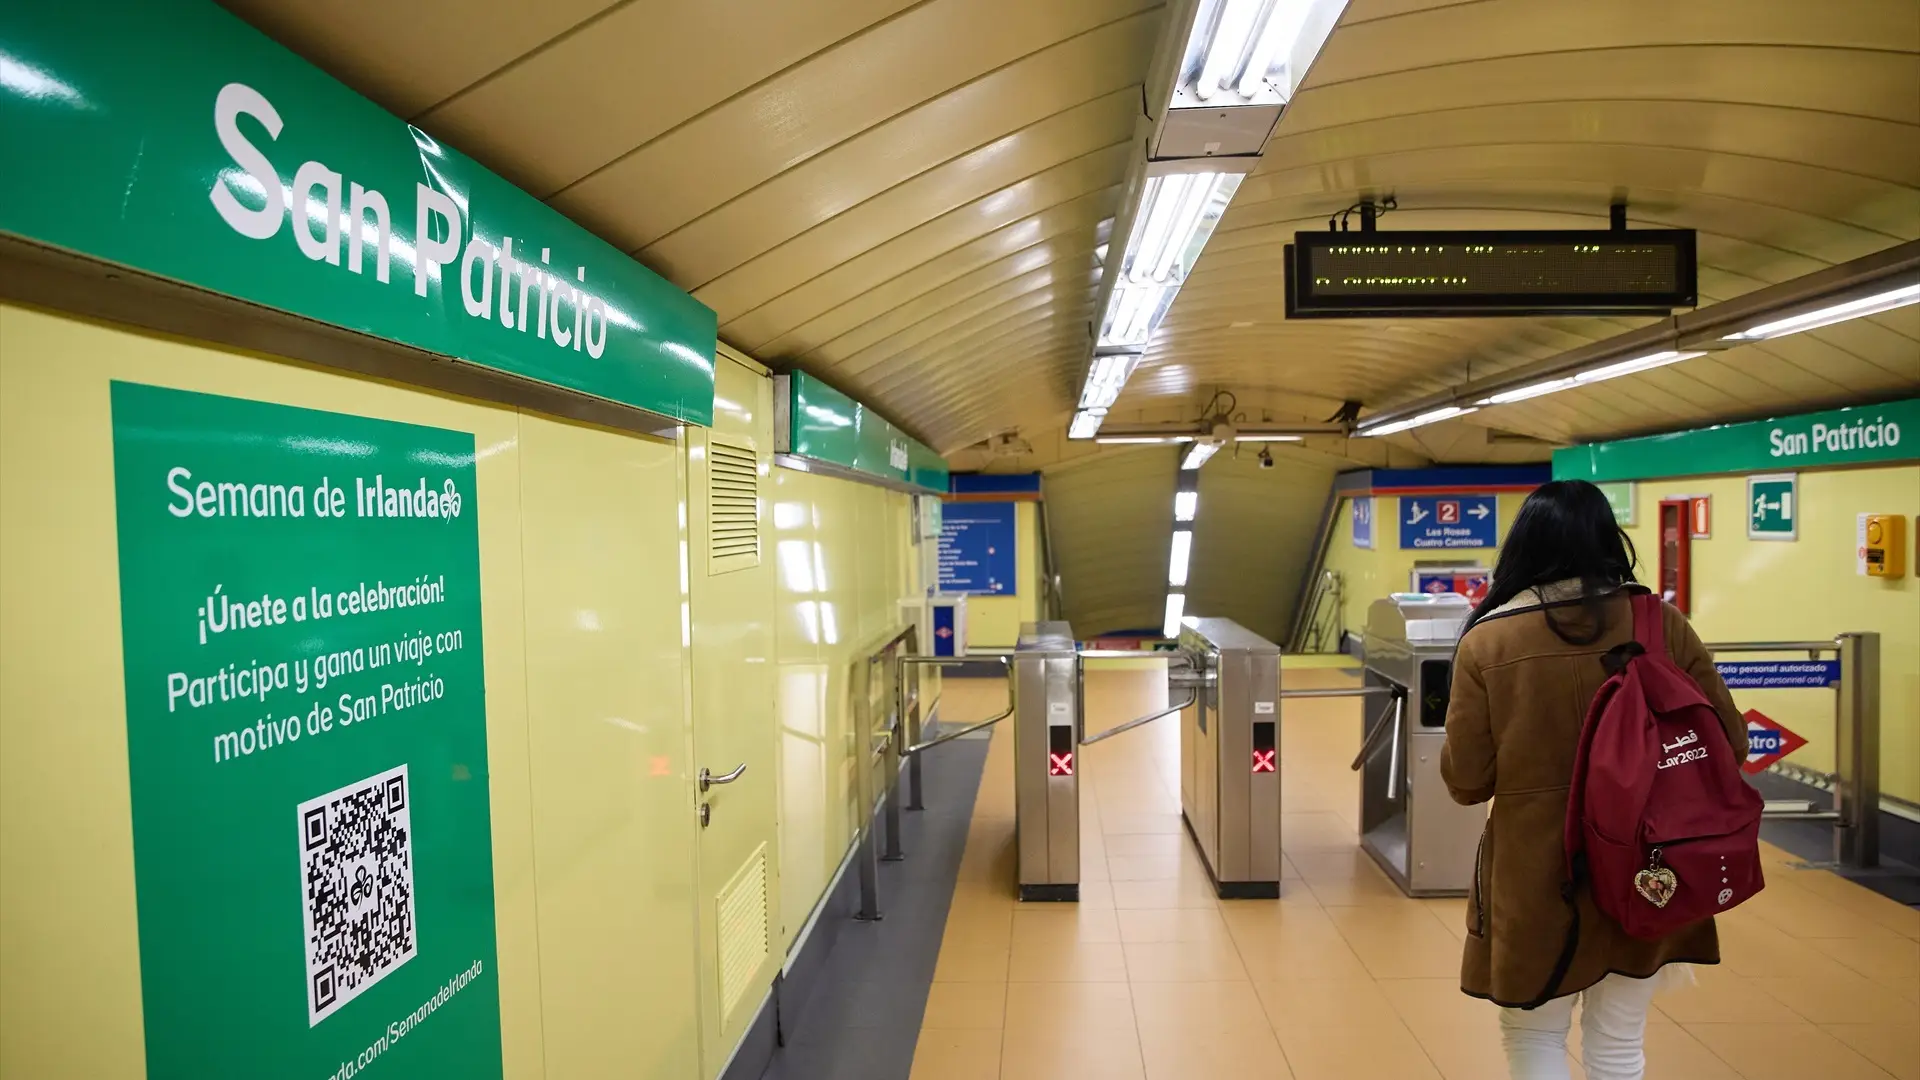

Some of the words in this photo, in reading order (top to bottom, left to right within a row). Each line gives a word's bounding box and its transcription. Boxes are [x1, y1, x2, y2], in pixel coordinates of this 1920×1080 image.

[209, 82, 391, 285] San
[414, 182, 607, 359] Patricio
[1769, 428, 1808, 457] San
[1811, 416, 1900, 453] Patricio
[166, 466, 304, 518] Semana
[313, 476, 346, 518] de
[356, 474, 440, 518] Irlanda
[1442, 504, 1455, 521] 2
[1413, 538, 1443, 548] Cuatro
[1444, 537, 1484, 548] Caminos
[1426, 528, 1442, 537] Las
[1443, 527, 1472, 537] Rosas
[197, 584, 287, 645] ¡Únete
[292, 598, 307, 622] a
[311, 586, 333, 620] la
[337, 575, 445, 616] celebración!
[166, 660, 288, 713] Participa
[295, 658, 309, 693] y
[314, 646, 364, 685] gana
[369, 641, 391, 667] un
[394, 629, 434, 666] viaje
[436, 628, 463, 654] con
[1716, 665, 1738, 674] Solo
[1739, 665, 1778, 675] personal
[1779, 664, 1827, 673] autorizado
[1724, 677, 1763, 685] uthorised
[1763, 677, 1806, 686] personnel
[1807, 676, 1825, 685] only
[213, 713, 301, 763] motivo
[306, 701, 333, 736] de
[338, 693, 377, 726] San
[382, 675, 444, 716] Patricio
[1662, 729, 1698, 754] قطر
[1748, 735, 1777, 749] etro
